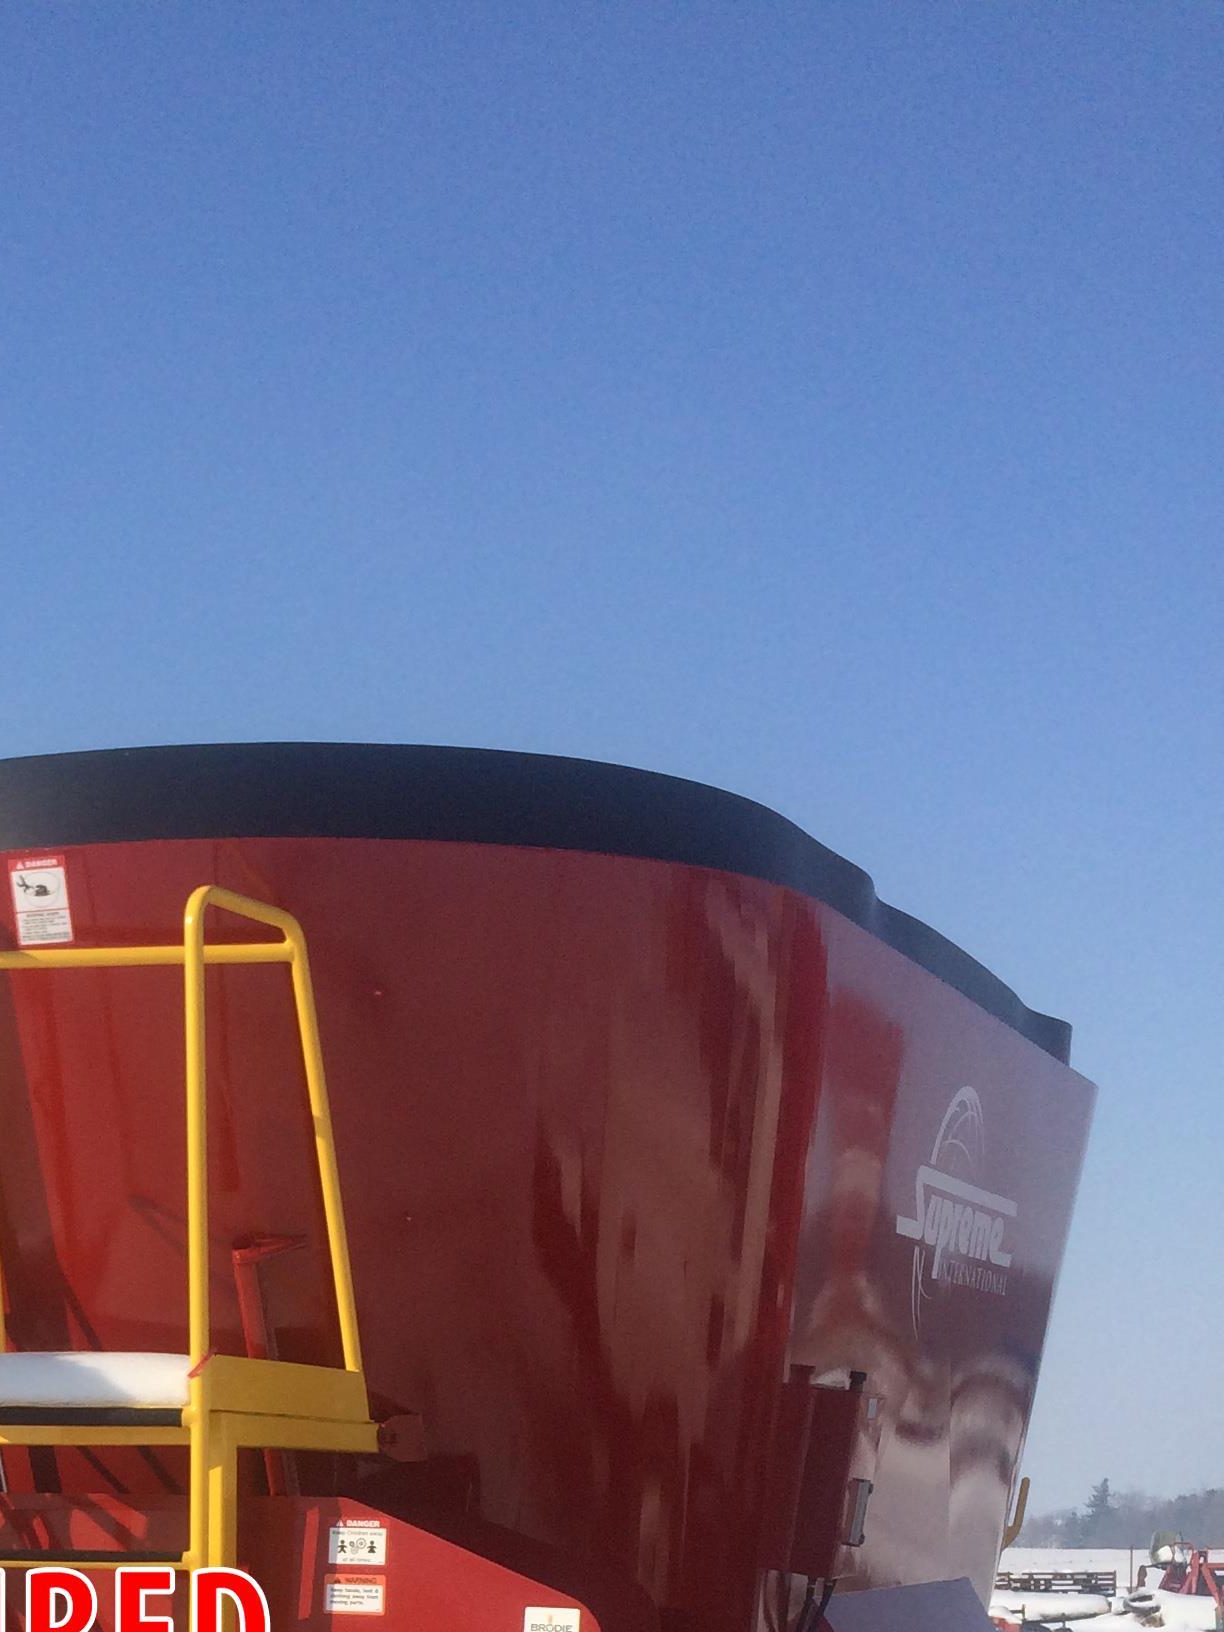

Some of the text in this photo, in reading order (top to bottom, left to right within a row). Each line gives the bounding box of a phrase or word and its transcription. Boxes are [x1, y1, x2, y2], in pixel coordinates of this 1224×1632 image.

[896, 1165, 1018, 1280] Supreme
[938, 1258, 1008, 1296] INTERNATIONAL
[346, 1520, 380, 1528] DANGER
[531, 1623, 573, 1632] BRODIE
